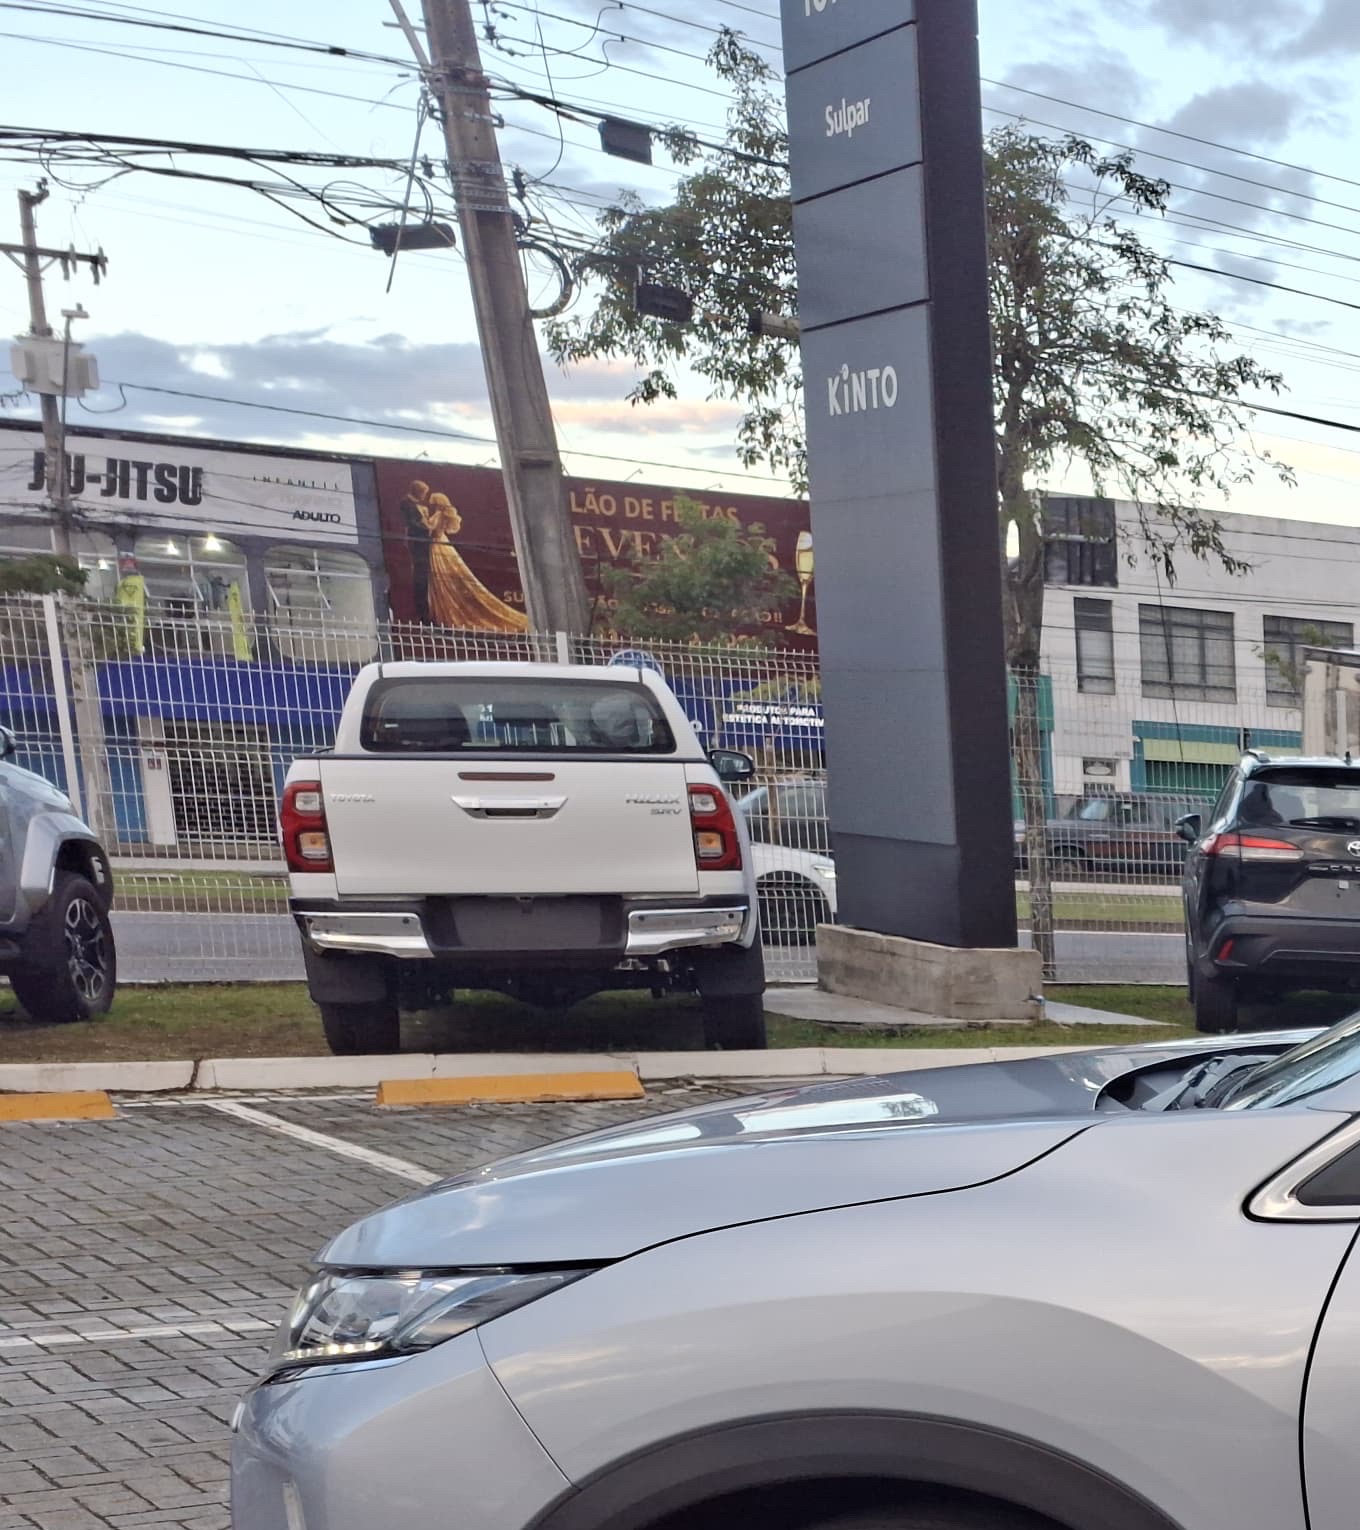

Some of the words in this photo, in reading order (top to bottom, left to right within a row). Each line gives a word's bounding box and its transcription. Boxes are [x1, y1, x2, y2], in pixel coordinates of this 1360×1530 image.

[825, 97, 871, 137] Sulpar
[28, 451, 202, 506] JU-JITSU
[293, 510, 341, 524] ADULTO
[569, 487, 616, 516] LÃO
[624, 496, 653, 520] DE
[661, 500, 738, 525] FETAS
